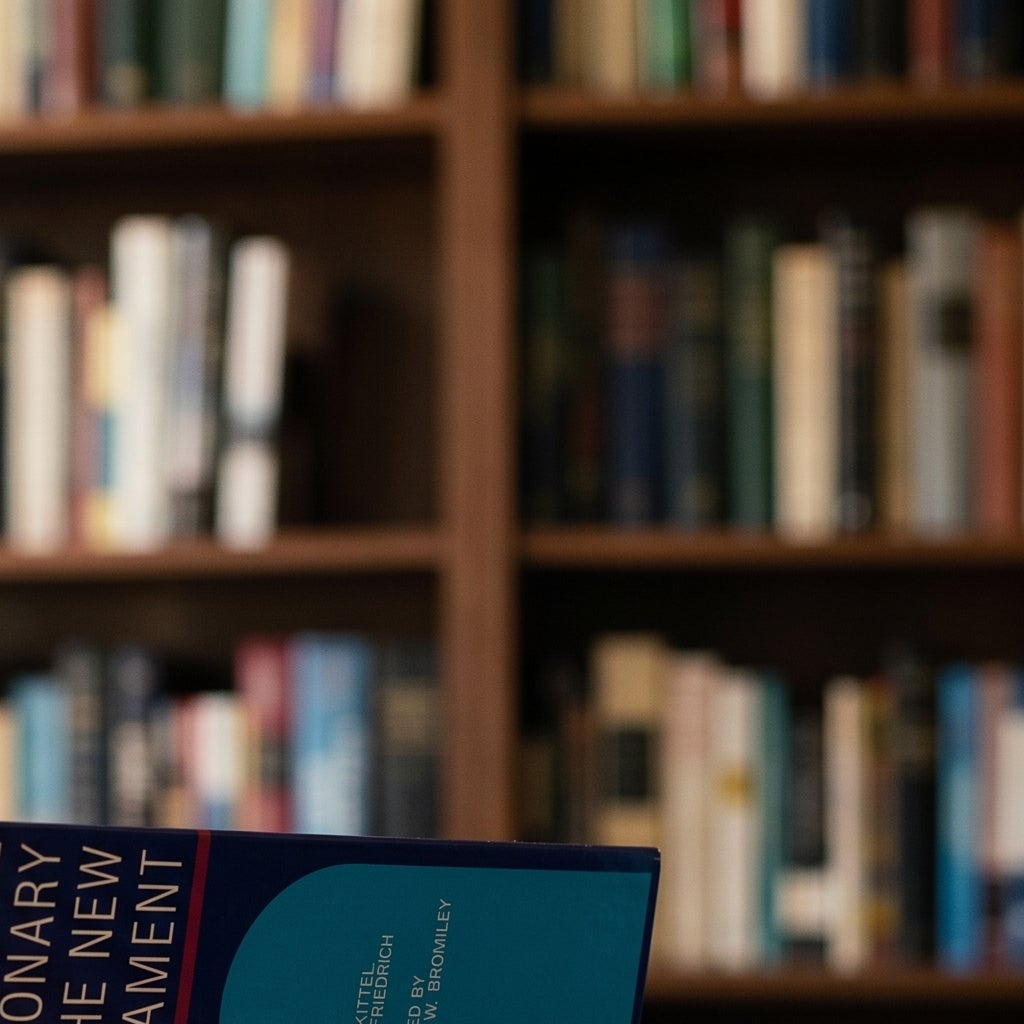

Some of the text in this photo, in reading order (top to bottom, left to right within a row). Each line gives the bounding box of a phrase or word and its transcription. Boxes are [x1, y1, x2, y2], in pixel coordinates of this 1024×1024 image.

[68, 845, 122, 958] NEW
[428, 899, 452, 992] BROMILEY
[411, 975, 425, 998] BY
[423, 1001, 438, 1021] W.
